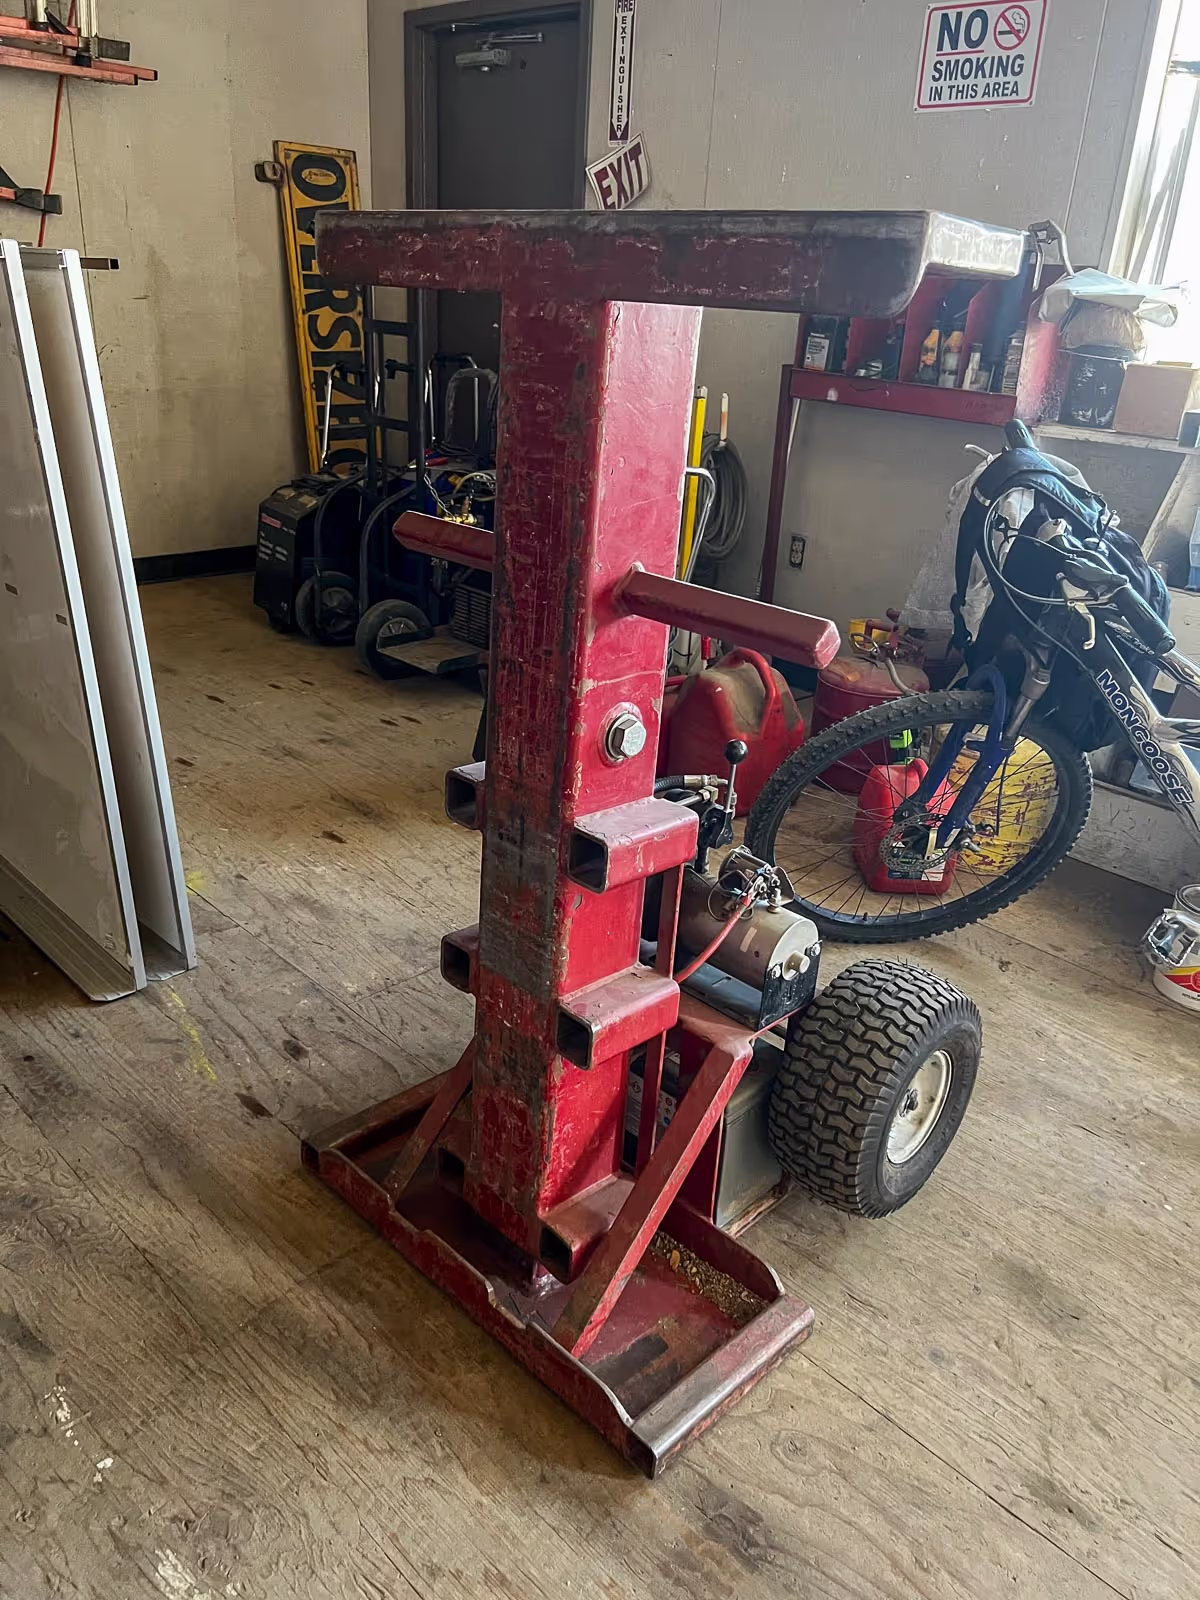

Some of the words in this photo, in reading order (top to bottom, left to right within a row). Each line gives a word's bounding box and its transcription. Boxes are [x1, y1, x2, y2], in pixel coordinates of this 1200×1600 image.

[616, 0, 634, 14] FIRE
[936, 9, 989, 52] NO
[616, 16, 628, 133] EXTINGUISHER
[931, 54, 1025, 82] SMOKING
[929, 85, 944, 101] IN
[947, 83, 978, 100] THIS
[981, 81, 1019, 98] AREA
[594, 142, 643, 210] EXIT
[1096, 669, 1195, 805] MONGOOSE
